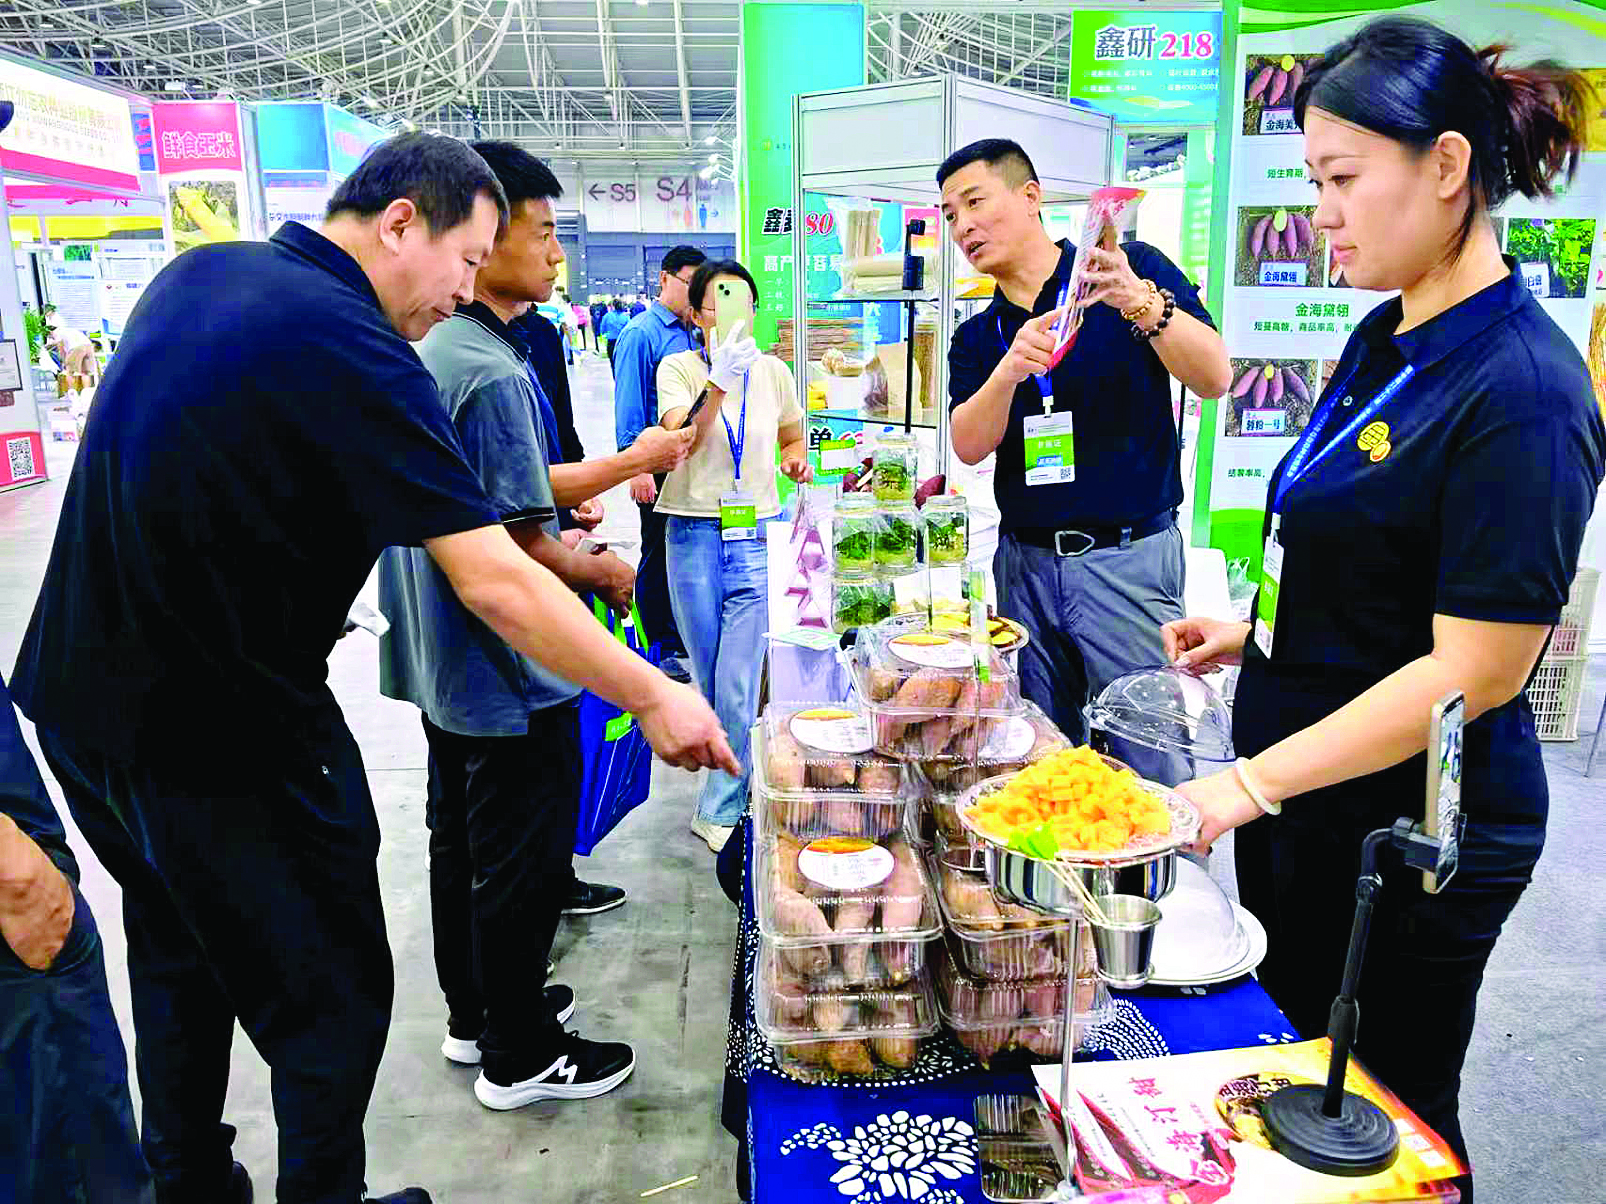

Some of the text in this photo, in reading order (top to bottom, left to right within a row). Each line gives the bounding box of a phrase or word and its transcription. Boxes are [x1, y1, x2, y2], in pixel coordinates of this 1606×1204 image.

[1095, 25, 1214, 60] 鑫研218
[1265, 118, 1299, 131] 金海美
[161, 130, 236, 158] 鲜食玉米
[610, 182, 637, 202] S5
[656, 176, 693, 201] S4
